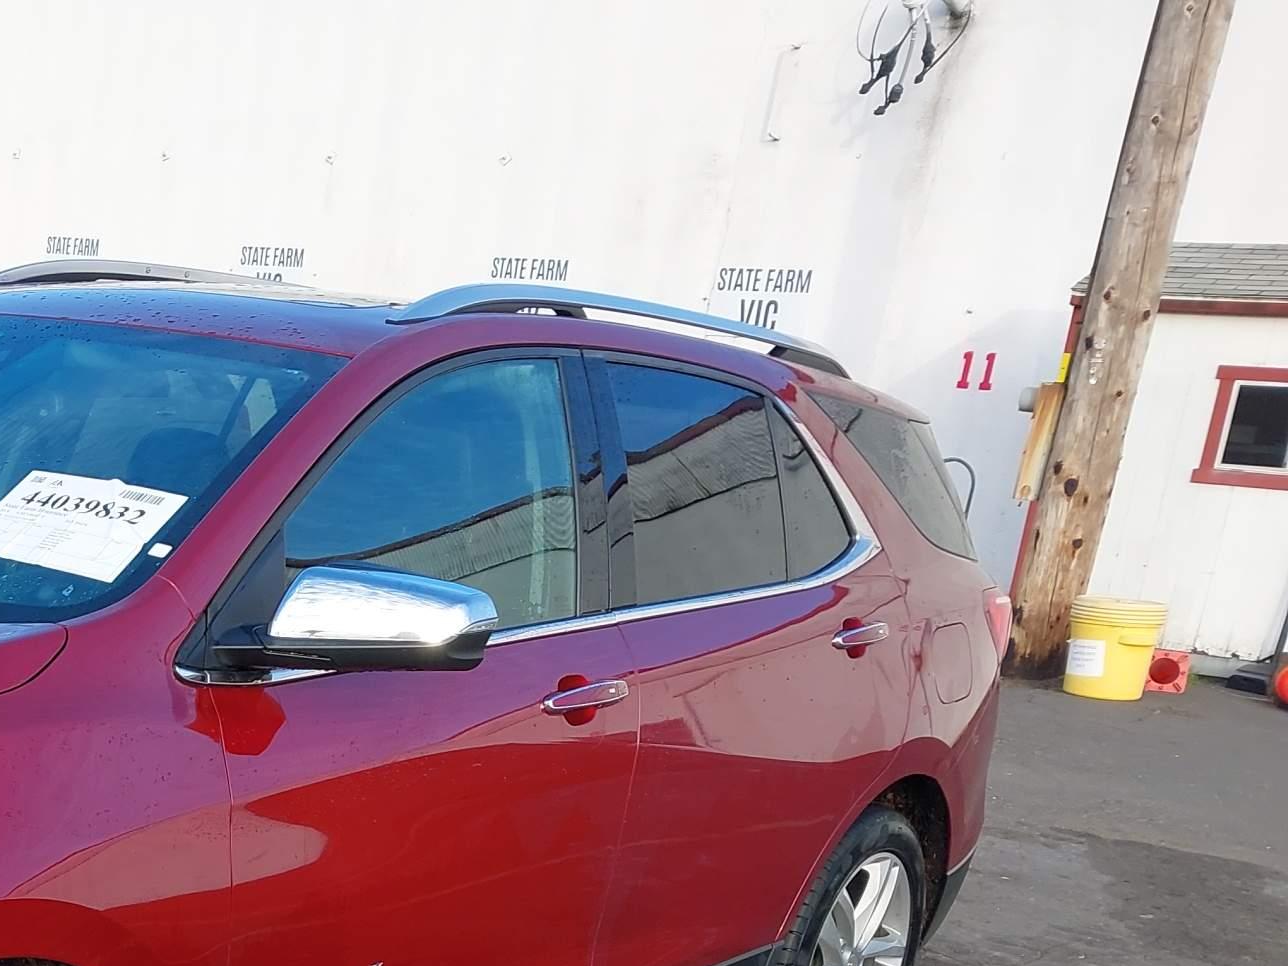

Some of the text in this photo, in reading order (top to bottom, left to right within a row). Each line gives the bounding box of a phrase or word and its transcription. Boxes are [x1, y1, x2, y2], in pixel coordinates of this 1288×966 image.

[46, 236, 100, 256] STATE FARM
[240, 246, 305, 268] STATE FARM
[491, 257, 569, 281] STATE FARM
[717, 267, 813, 294] STATE FARM
[740, 298, 779, 330] VIC
[956, 351, 998, 391] 11
[21, 489, 147, 525] 44039832
